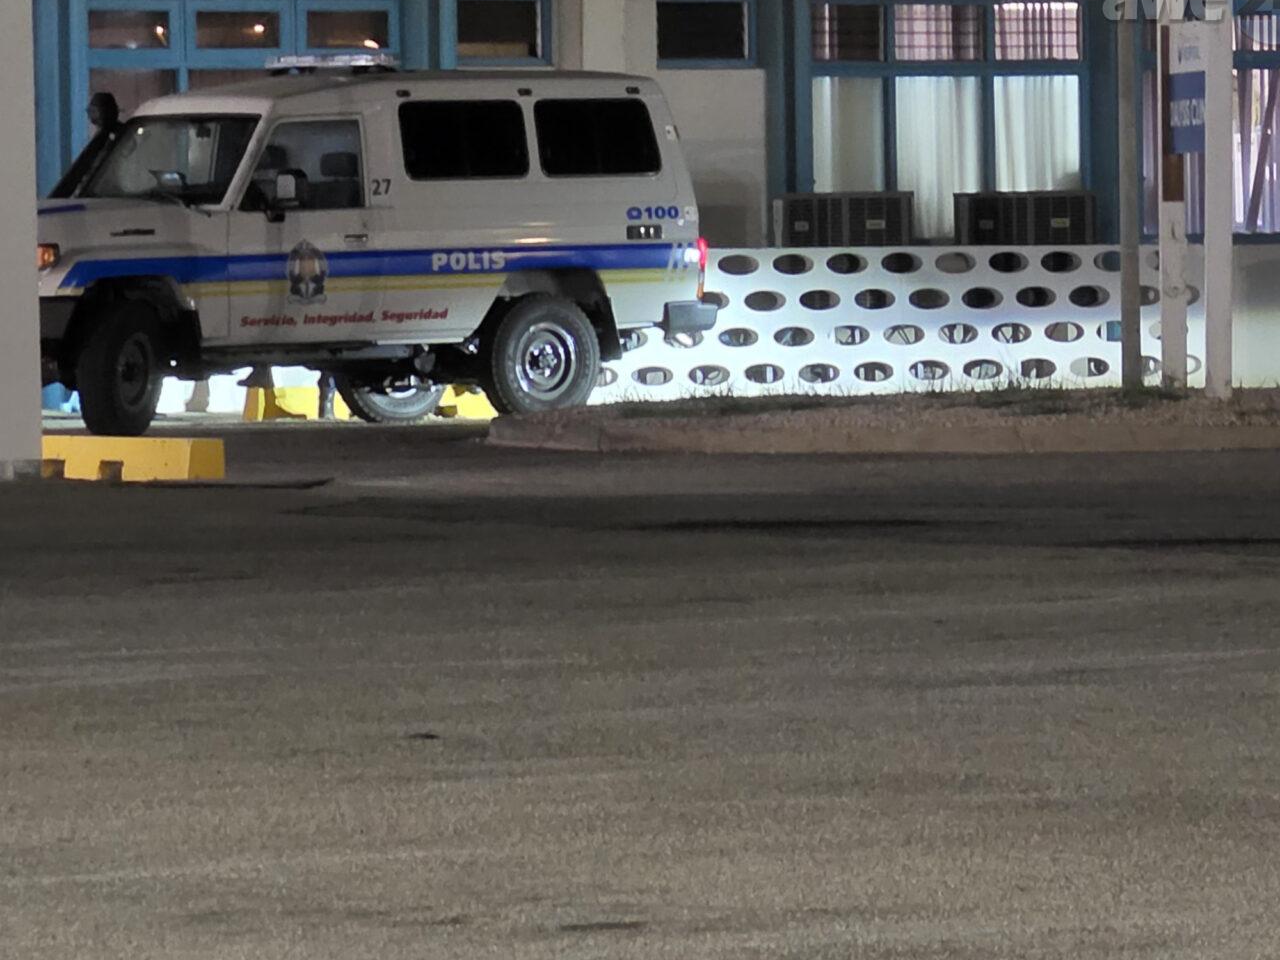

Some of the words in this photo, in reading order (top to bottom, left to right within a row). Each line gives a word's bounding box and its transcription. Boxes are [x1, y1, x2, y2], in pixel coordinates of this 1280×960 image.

[371, 178, 391, 196] 27
[431, 251, 506, 271] POLIS
[381, 308, 448, 324] Seguridad
